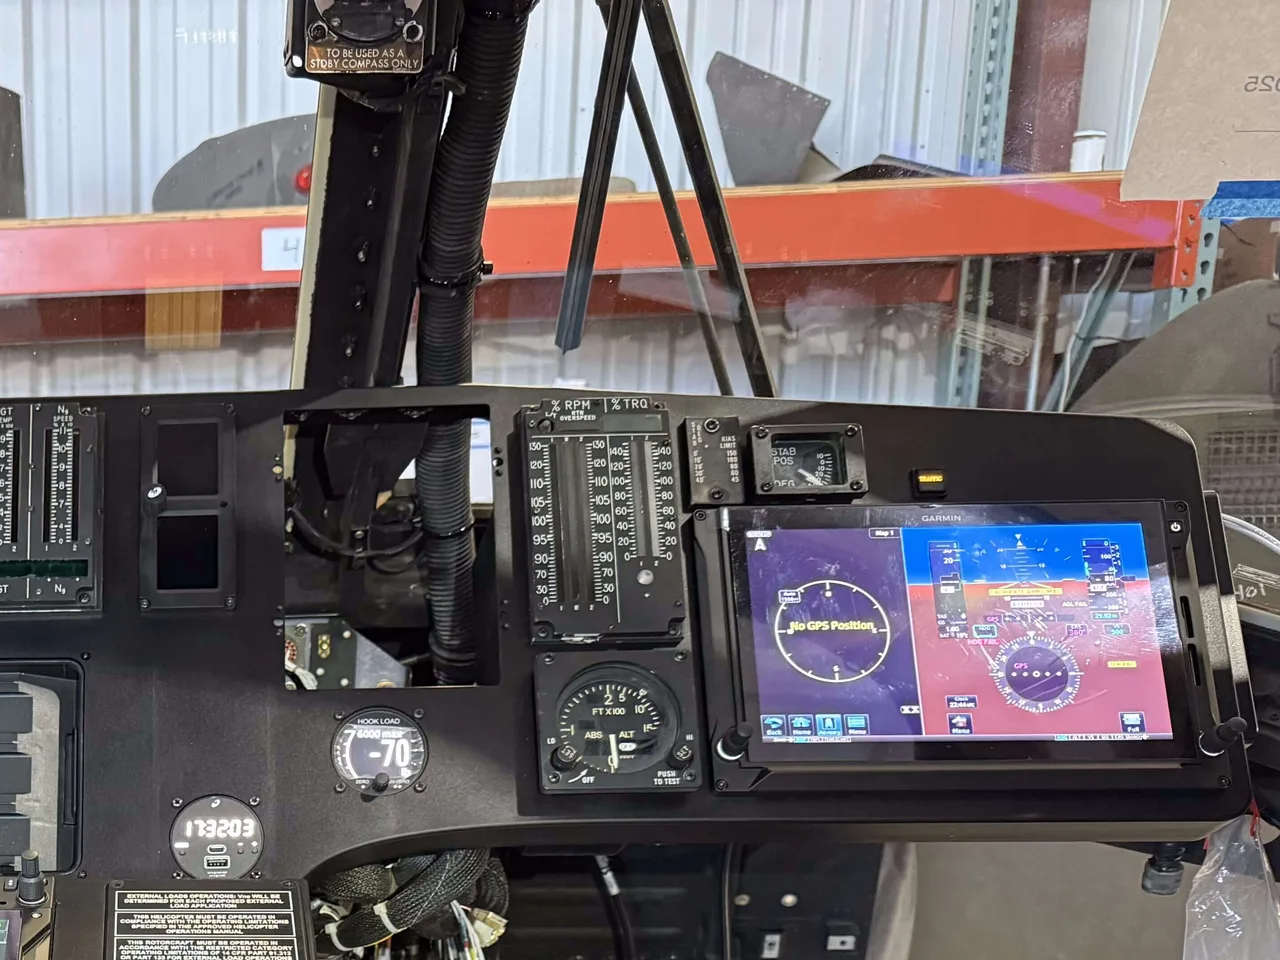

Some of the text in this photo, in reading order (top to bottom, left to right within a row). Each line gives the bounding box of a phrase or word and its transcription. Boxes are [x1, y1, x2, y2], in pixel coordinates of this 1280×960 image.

[327, 49, 404, 57] TO BE USED AS A
[310, 60, 419, 69] STDBY COMPASS ONLY
[551, 399, 648, 411] % RPM % TRQ
[790, 621, 874, 631] No GPS Position
[357, 730, 380, 739] 6000
[369, 739, 410, 767] -70
